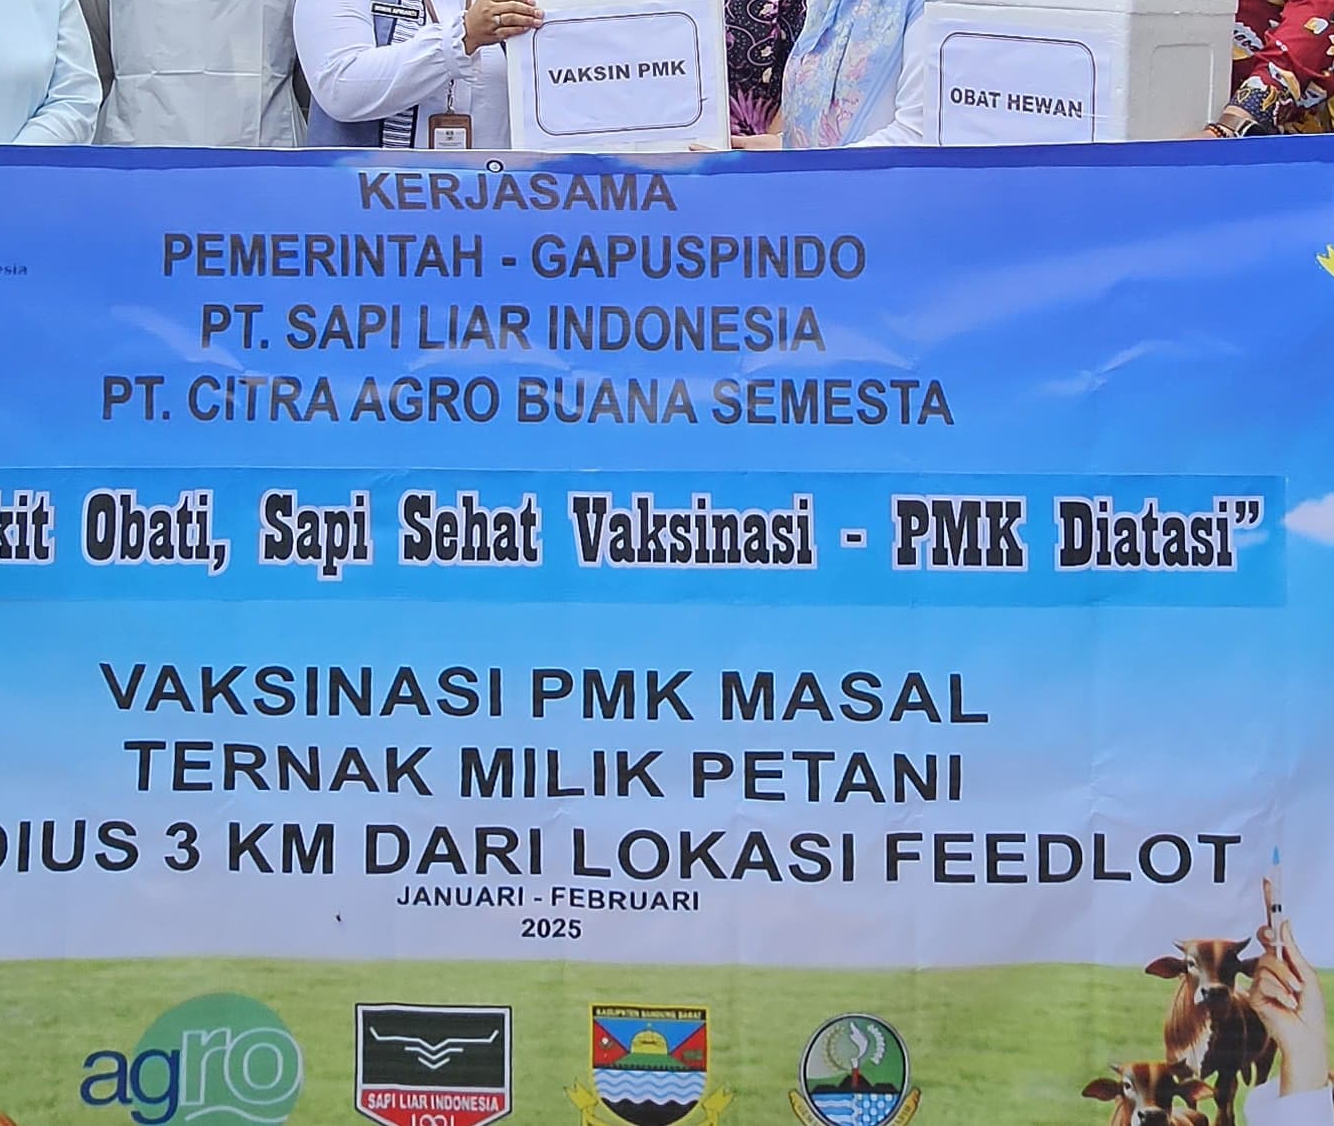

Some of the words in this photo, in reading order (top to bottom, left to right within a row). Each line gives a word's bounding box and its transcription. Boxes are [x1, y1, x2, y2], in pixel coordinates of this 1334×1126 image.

[548, 63, 631, 84] VAKSIN
[638, 59, 686, 78] PMK
[950, 87, 1001, 109] OBAT
[1006, 95, 1083, 120] HEWAN
[357, 171, 678, 212] KERJASAMA
[163, 233, 483, 278] PEMERINTAH
[531, 233, 866, 280] GAPUSPINDO
[201, 303, 269, 350] PT.
[286, 304, 401, 350] SAPI
[418, 304, 531, 350] LIAR
[548, 305, 826, 353] INDONESIA
[102, 375, 170, 421] PT.
[186, 375, 342, 423] CITRA
[350, 376, 500, 423] AGRO
[517, 376, 700, 425] BUANA
[712, 378, 955, 426] SEMESTA
[86, 493, 226, 571] Obati,
[264, 493, 368, 576] Sapi
[403, 494, 538, 562] Sehat
[572, 496, 813, 565] Vaksinasi
[896, 499, 1024, 567] PMK
[99, 662, 502, 717] VAKSINASI
[532, 668, 694, 721] PMK
[721, 671, 989, 724] MASAL
[123, 740, 433, 796] TERNAK
[460, 747, 665, 798] MILIK
[692, 750, 962, 803] PETANI
[164, 821, 200, 872] 3
[228, 821, 335, 875] KM
[365, 824, 542, 875] DARI
[573, 828, 855, 883] LOKASI
[886, 832, 1242, 884] FEEDLOT
[396, 885, 524, 907] JANUARI
[551, 886, 699, 911] FEBRUARI
[521, 918, 582, 940] 2025
[79, 1027, 304, 1126] agro
[367, 1092, 396, 1110] SAPI
[399, 1093, 428, 1110] LIAR
[430, 1094, 500, 1113] INDONESIA
